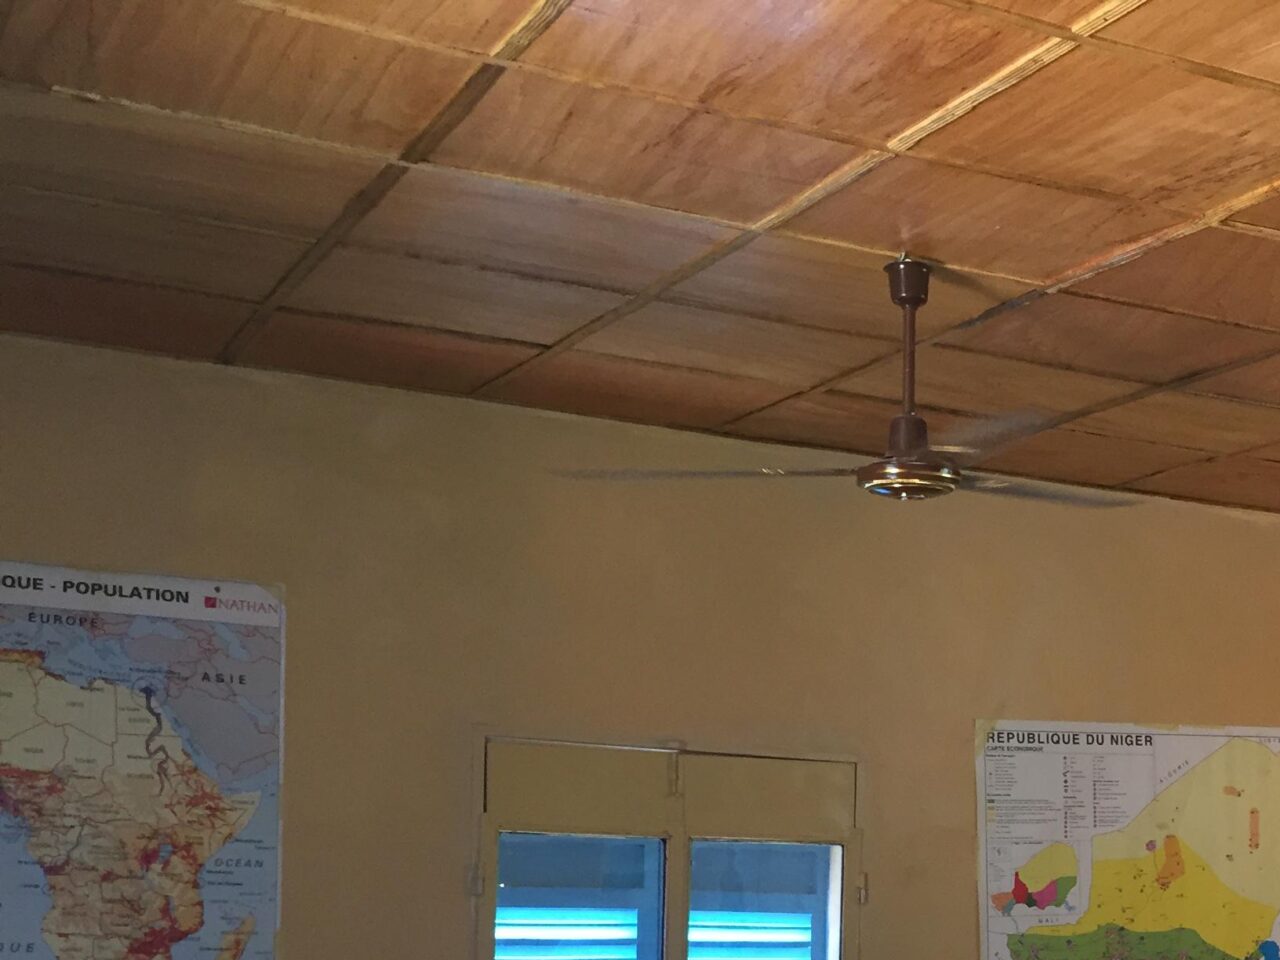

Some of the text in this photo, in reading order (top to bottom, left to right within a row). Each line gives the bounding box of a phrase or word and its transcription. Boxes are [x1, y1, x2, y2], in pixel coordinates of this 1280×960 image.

[1, 575, 44, 591] QUE
[62, 580, 190, 604] POPULATION
[217, 598, 279, 614] NATHAN
[28, 612, 98, 628] EUROPE
[202, 672, 247, 685] ASIE
[1086, 734, 1104, 745] DU
[1110, 734, 1153, 747] NIGER
